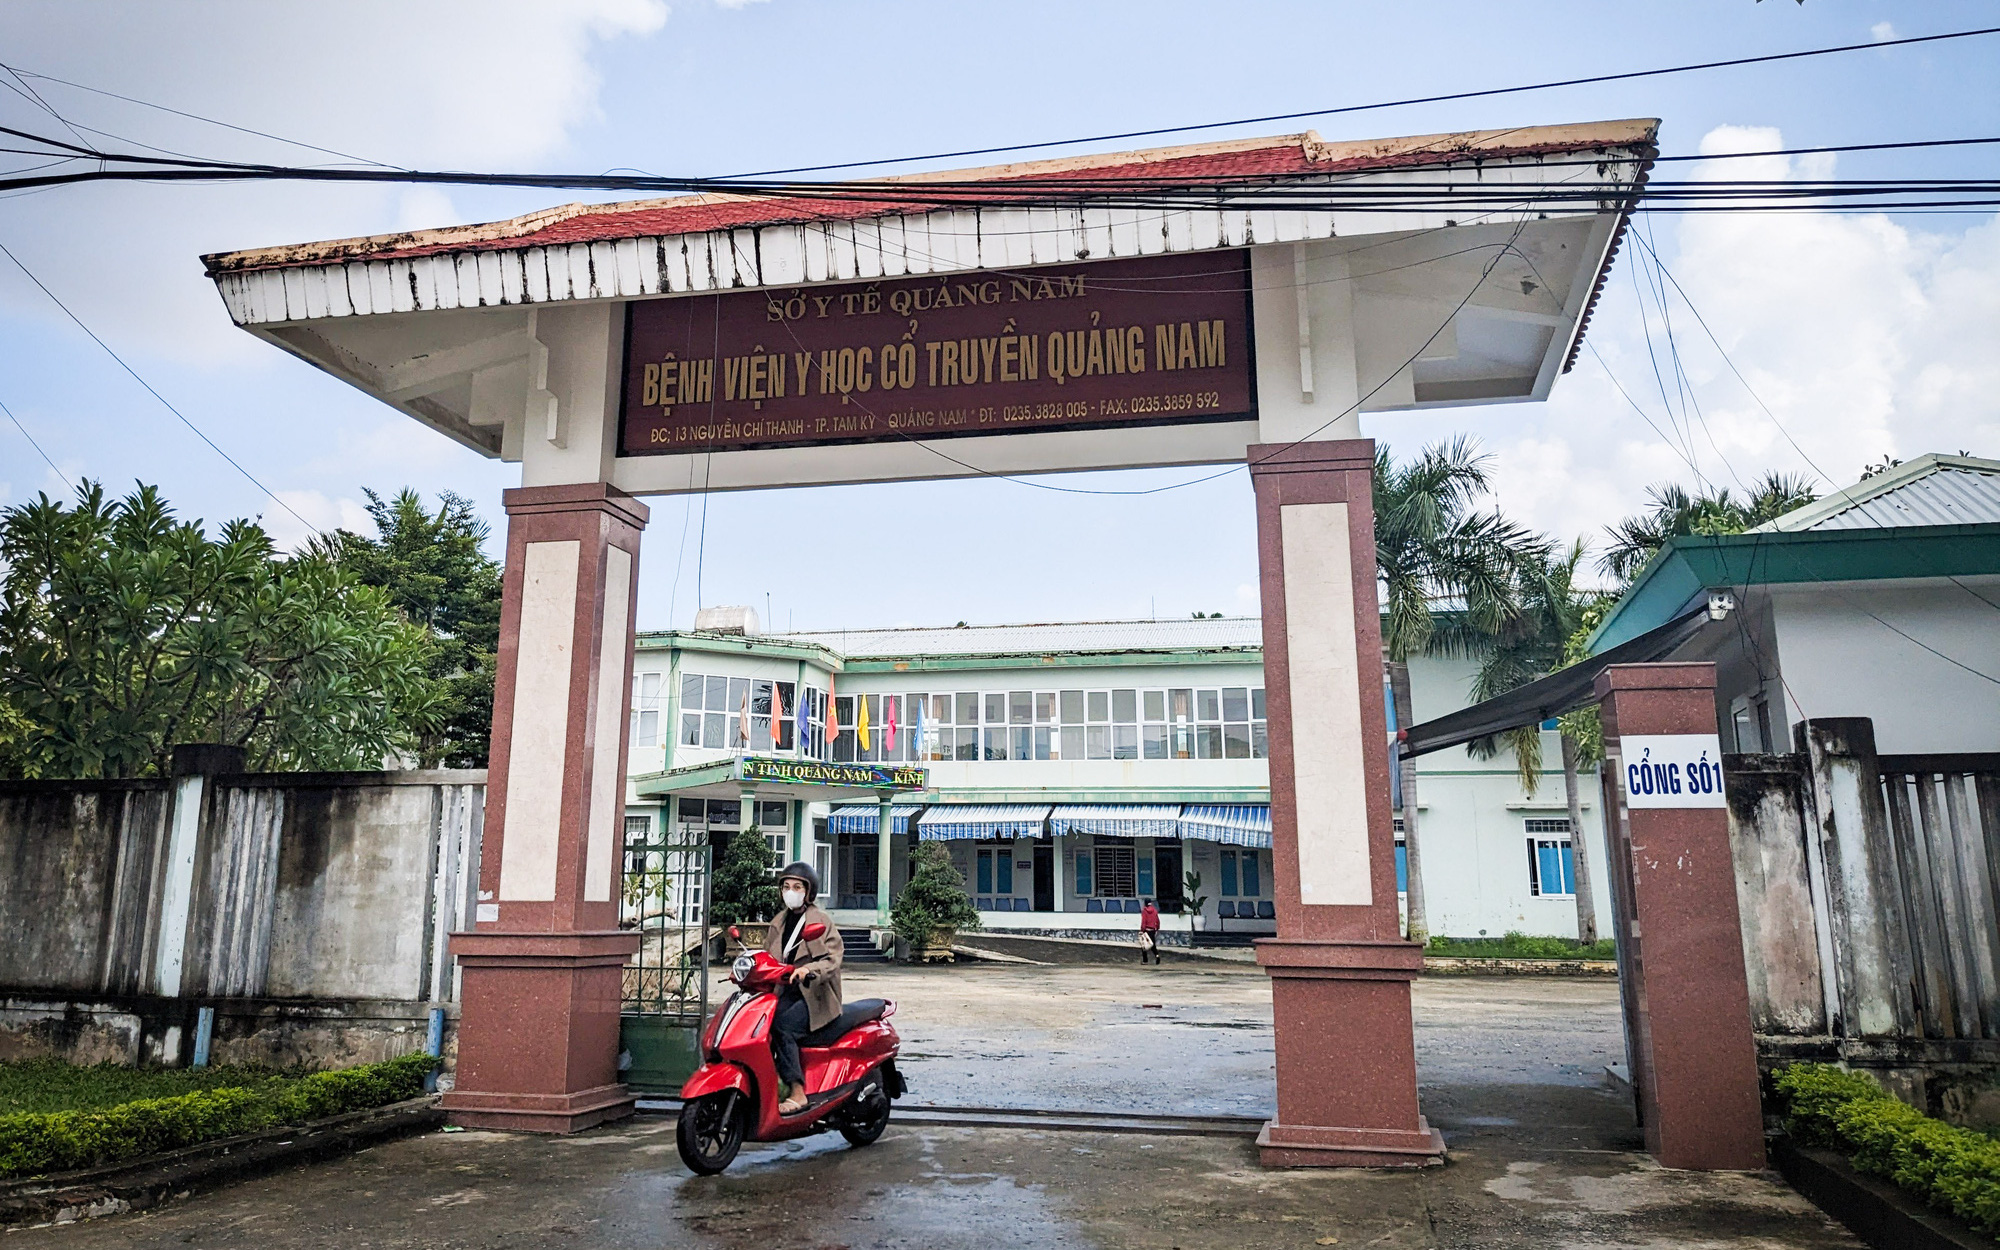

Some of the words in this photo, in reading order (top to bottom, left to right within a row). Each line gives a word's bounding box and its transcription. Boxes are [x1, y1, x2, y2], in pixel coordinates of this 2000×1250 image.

[766, 289, 807, 322] SỞ
[813, 296, 834, 319] Y
[840, 282, 881, 316] TẾ
[889, 276, 1002, 317] QUẢNG
[1009, 273, 1087, 302] NAM
[642, 351, 713, 416] BỆNH
[724, 344, 786, 410] VIỆN
[795, 351, 812, 396] Y
[820, 346, 873, 405] HỌC
[880, 319, 919, 390] CỔ
[926, 317, 1038, 387] TRUYỀN
[1047, 311, 1145, 385] QUẢNG
[1155, 319, 1226, 371] NAM
[675, 426, 687, 442] 13
[743, 418, 763, 437] CHÍ
[766, 419, 804, 436] THANH
[815, 418, 829, 433] TP.
[833, 416, 857, 432] TAM
[888, 407, 934, 428] QUẢNG
[939, 409, 967, 426] NAM
[979, 407, 997, 423] ĐT:
[1003, 402, 1063, 422] 0235.3828
[1066, 402, 1088, 418] 005
[1100, 399, 1128, 415] FAX:
[1131, 394, 1192, 413] 0235.3859
[1196, 391, 1220, 409] 592
[794, 763, 840, 780] QUẢNG
[843, 768, 872, 782] NAM
[1628, 747, 1682, 795] CỔNG
